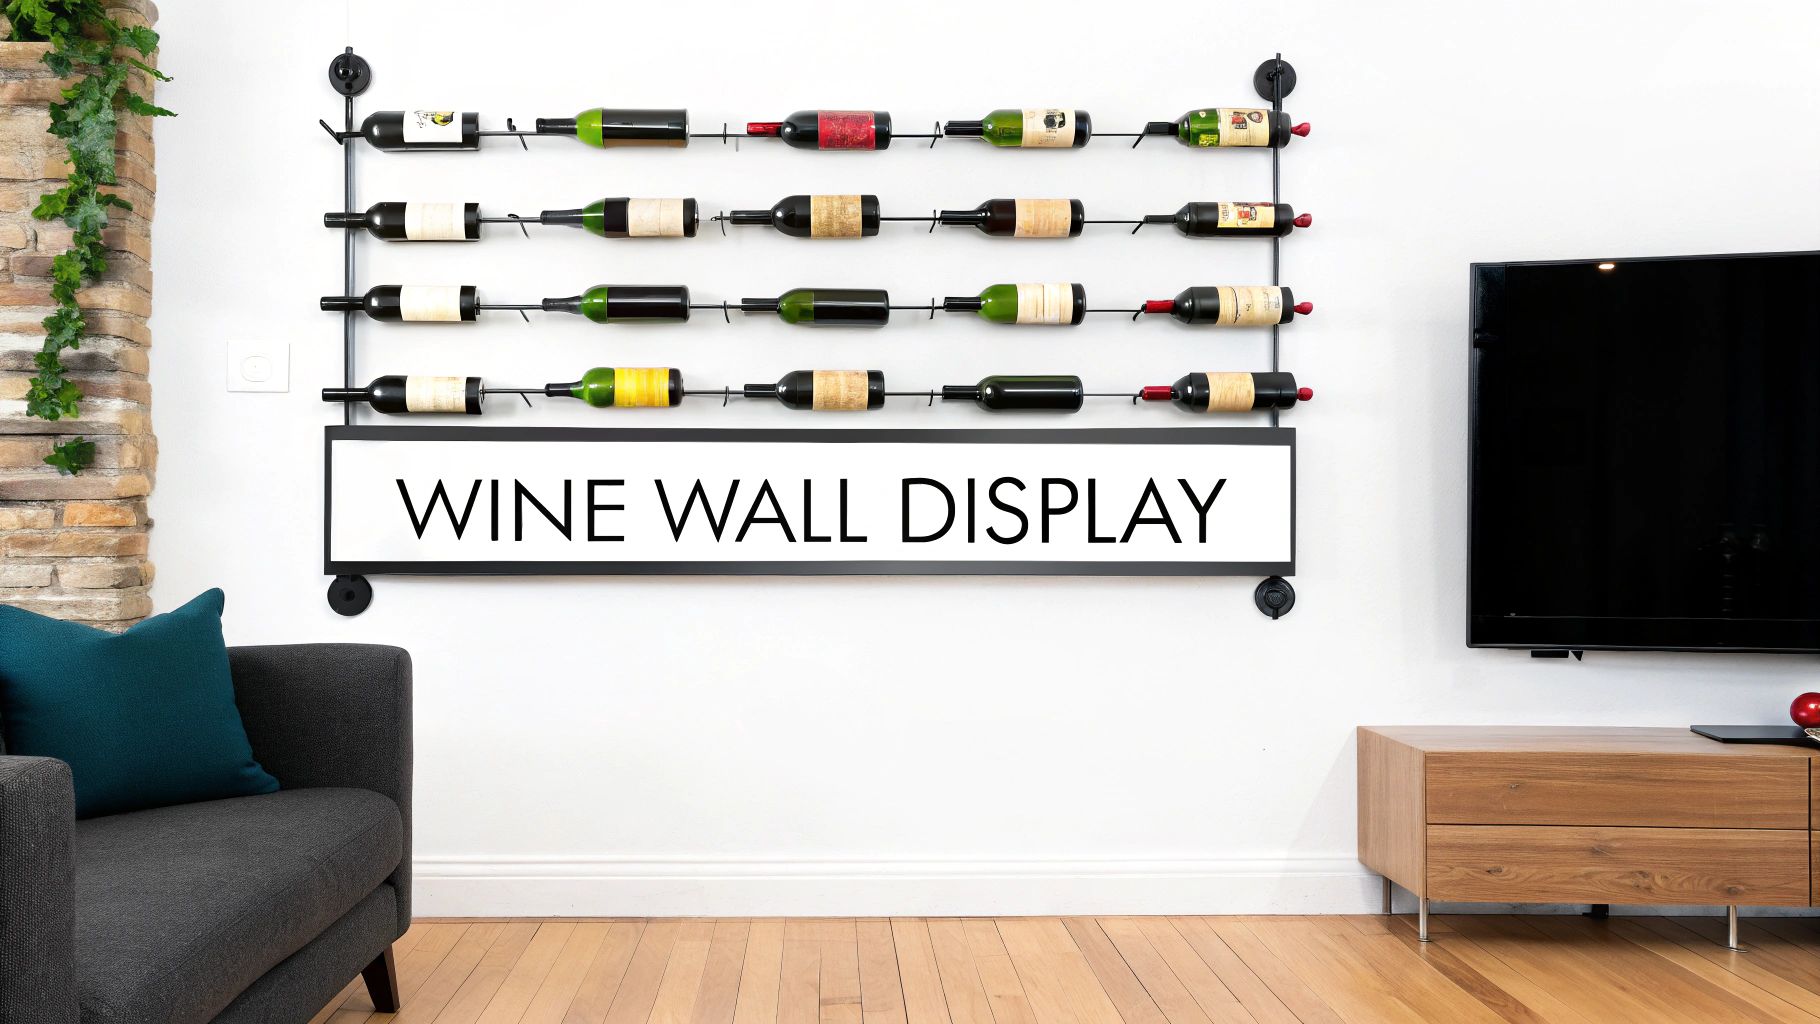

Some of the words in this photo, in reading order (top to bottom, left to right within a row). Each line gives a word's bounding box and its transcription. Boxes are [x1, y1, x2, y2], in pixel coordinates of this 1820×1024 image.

[396, 479, 625, 542] WINE
[655, 479, 868, 543] WALL
[902, 477, 1227, 544] DISPLAY
